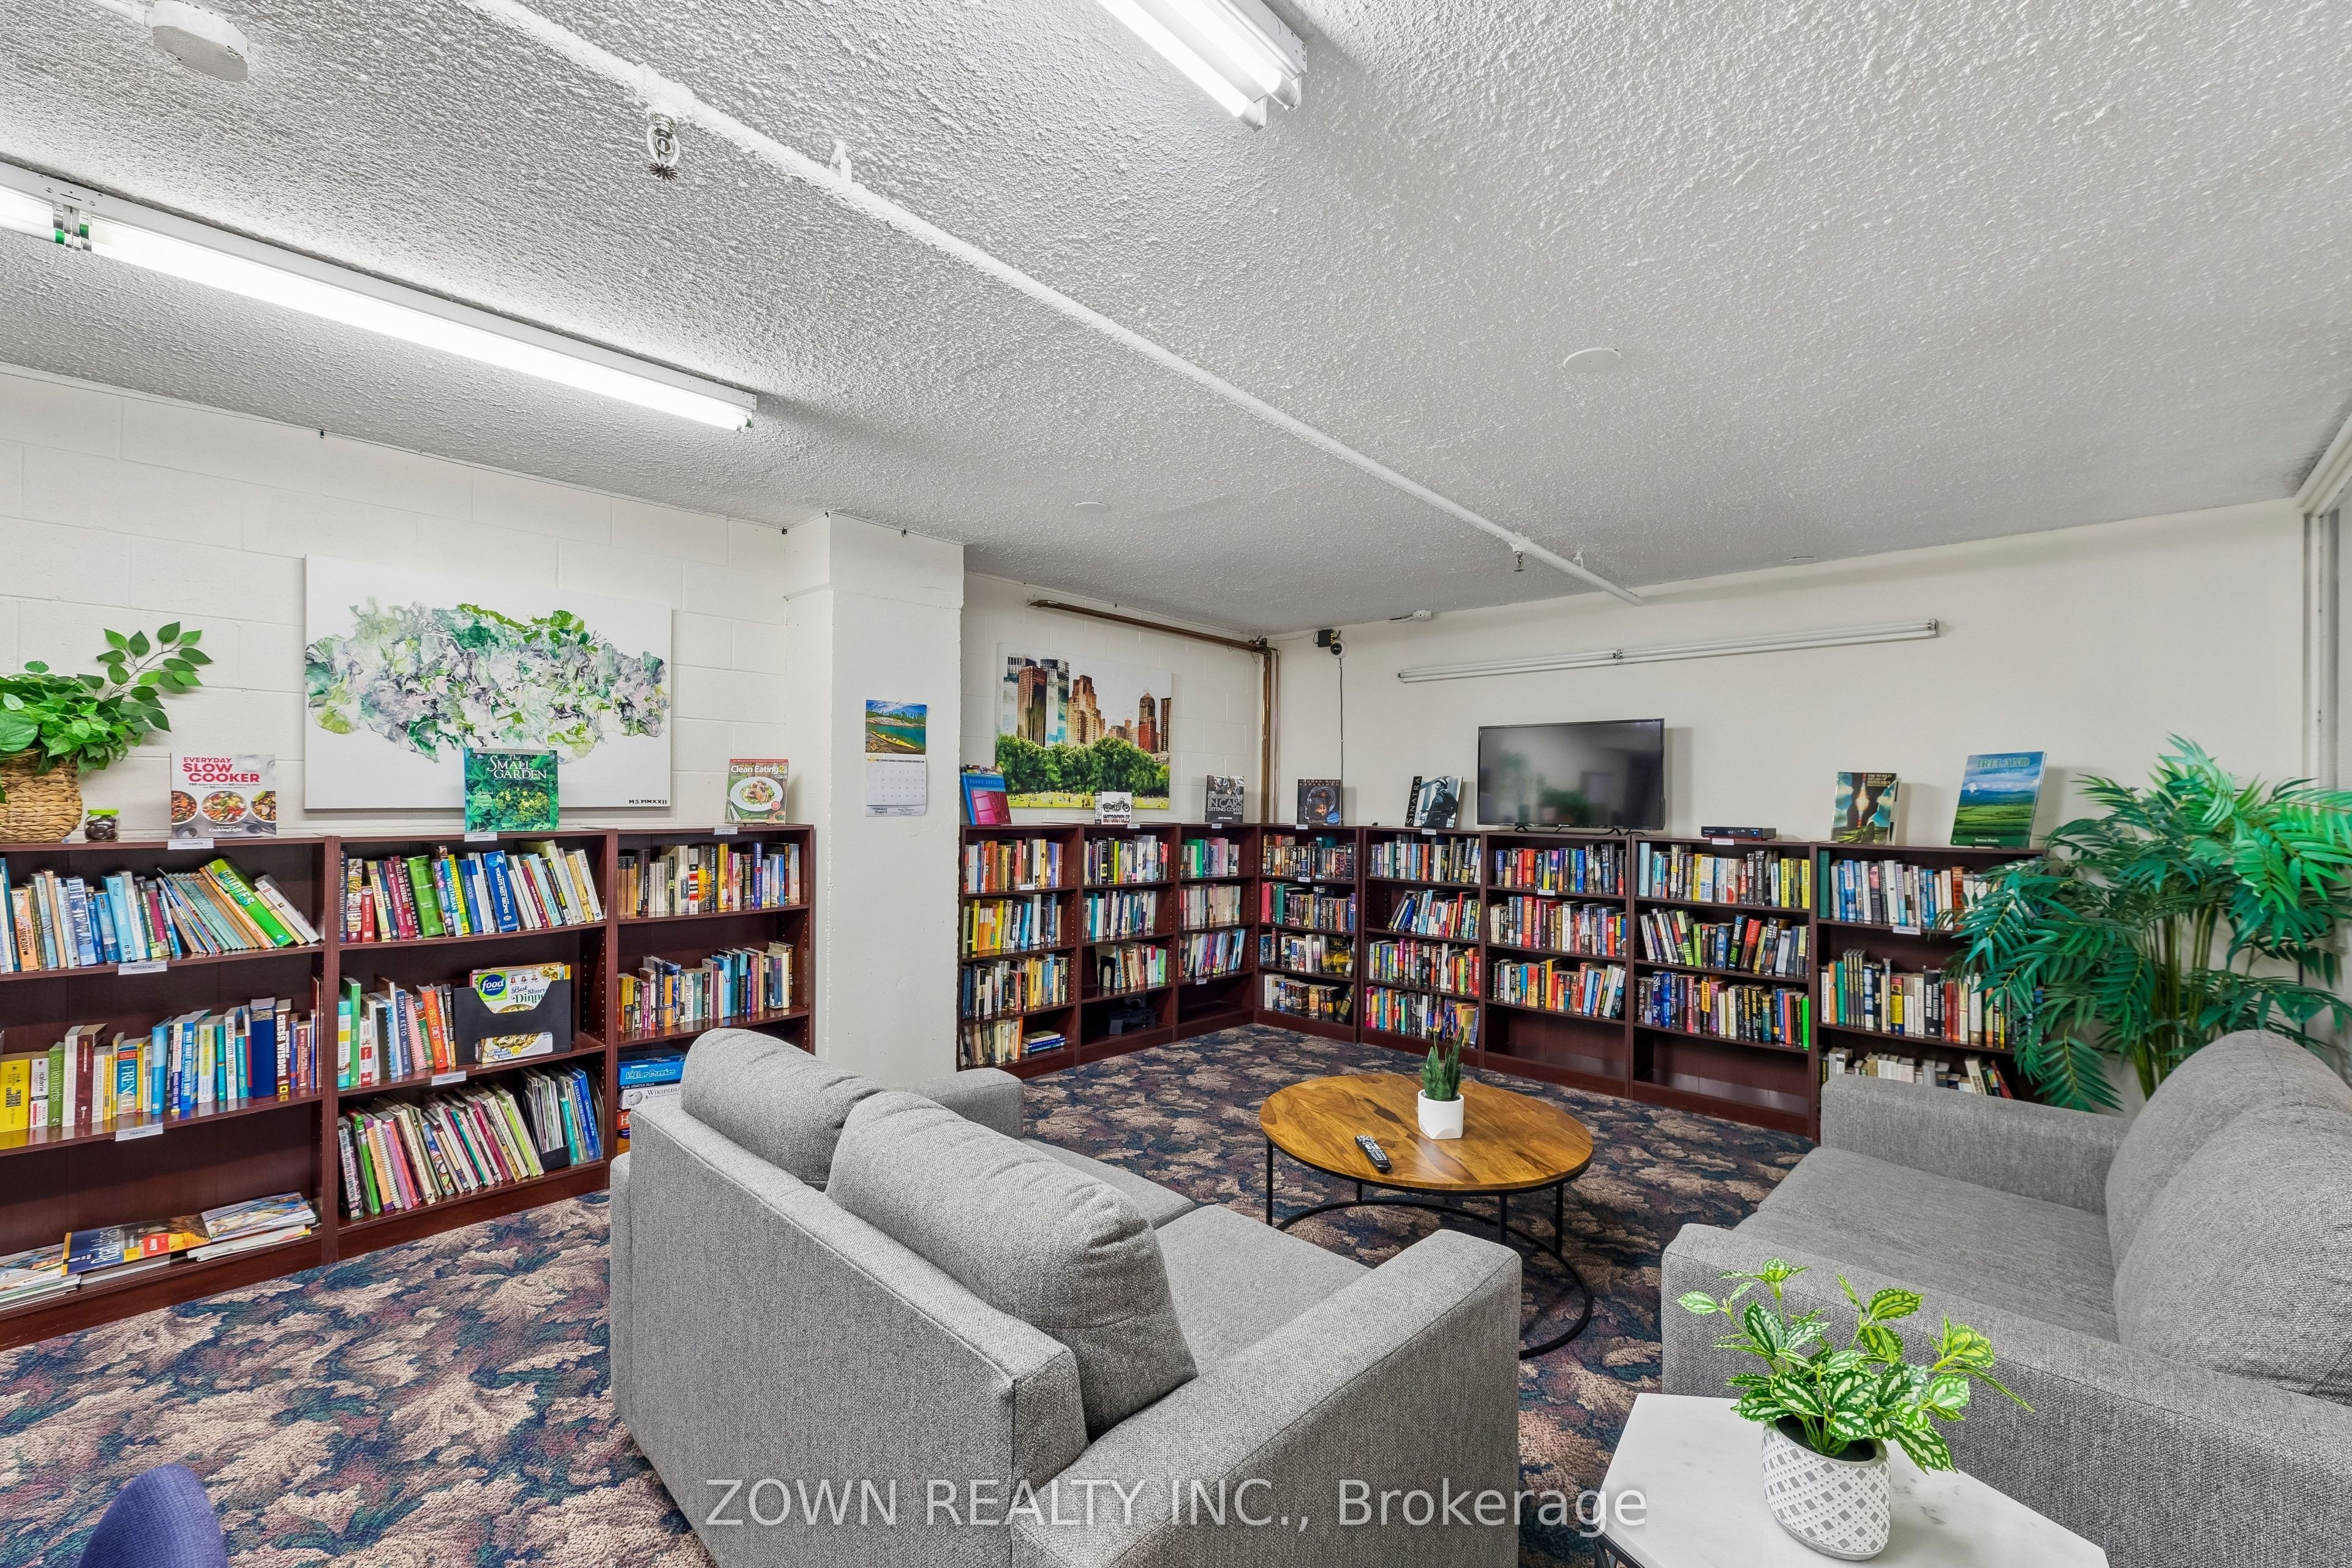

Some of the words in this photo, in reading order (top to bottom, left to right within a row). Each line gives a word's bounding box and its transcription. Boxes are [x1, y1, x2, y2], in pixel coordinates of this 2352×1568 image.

[183, 763, 233, 772] SLOW
[487, 755, 532, 771] SMALL
[755, 766, 778, 774] Eating
[1977, 757, 2030, 769] IRELAND
[189, 773, 260, 782] COOKER
[494, 770, 547, 779] GARDEN
[1208, 798, 1218, 807] IN
[1219, 799, 1243, 807] CARS
[1406, 778, 1420, 824] SINATRA
[396, 864, 404, 883] SIZZLING
[383, 891, 392, 910] yogurt
[399, 884, 408, 903] SAUSAGE
[447, 878, 457, 910] VEGETARIAN
[18, 928, 28, 951] SMEKDAY
[482, 978, 505, 993] food
[426, 993, 435, 1009] ZERO
[429, 1009, 437, 1027] BELLY
[277, 1014, 286, 1041] CHESS
[431, 1027, 440, 1039] DIET
[421, 1028, 431, 1055] vegetarian
[51, 1057, 61, 1080] Garden
[277, 1043, 286, 1076] WISDOM
[51, 1082, 62, 1102] Herbs
[121, 1065, 135, 1107] FRENCH
[91, 1229, 120, 1247] Atlas
